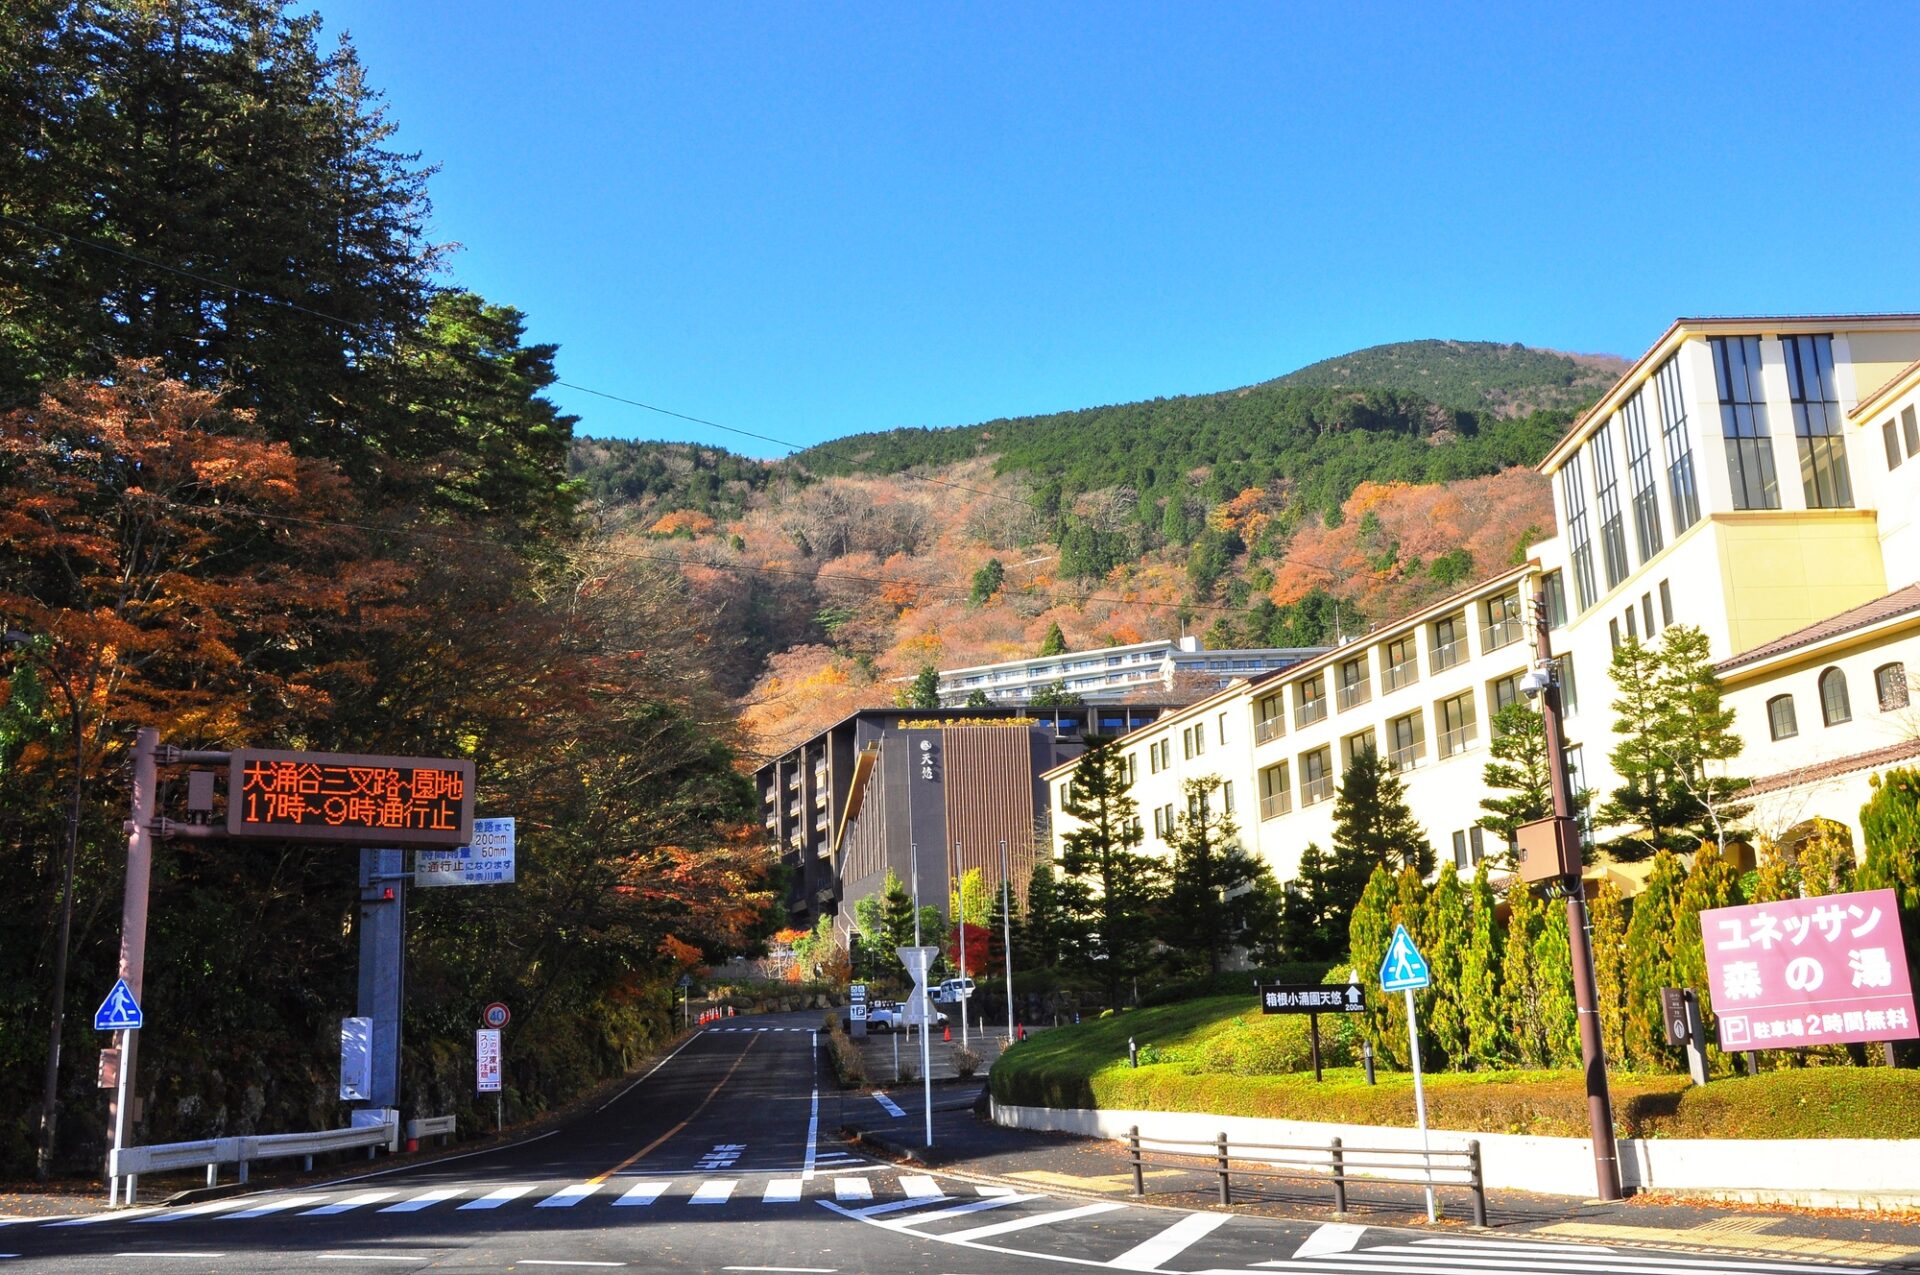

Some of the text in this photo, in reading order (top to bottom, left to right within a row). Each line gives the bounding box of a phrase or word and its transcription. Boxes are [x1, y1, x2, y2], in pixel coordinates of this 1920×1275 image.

[475, 834, 507, 846] 200mm
[1717, 904, 1882, 950] ユネッサン
[1266, 991, 1342, 1007] 箱根小涌園天悠
[1345, 1003, 1364, 1011] 200m
[490, 1010, 504, 1022] 40
